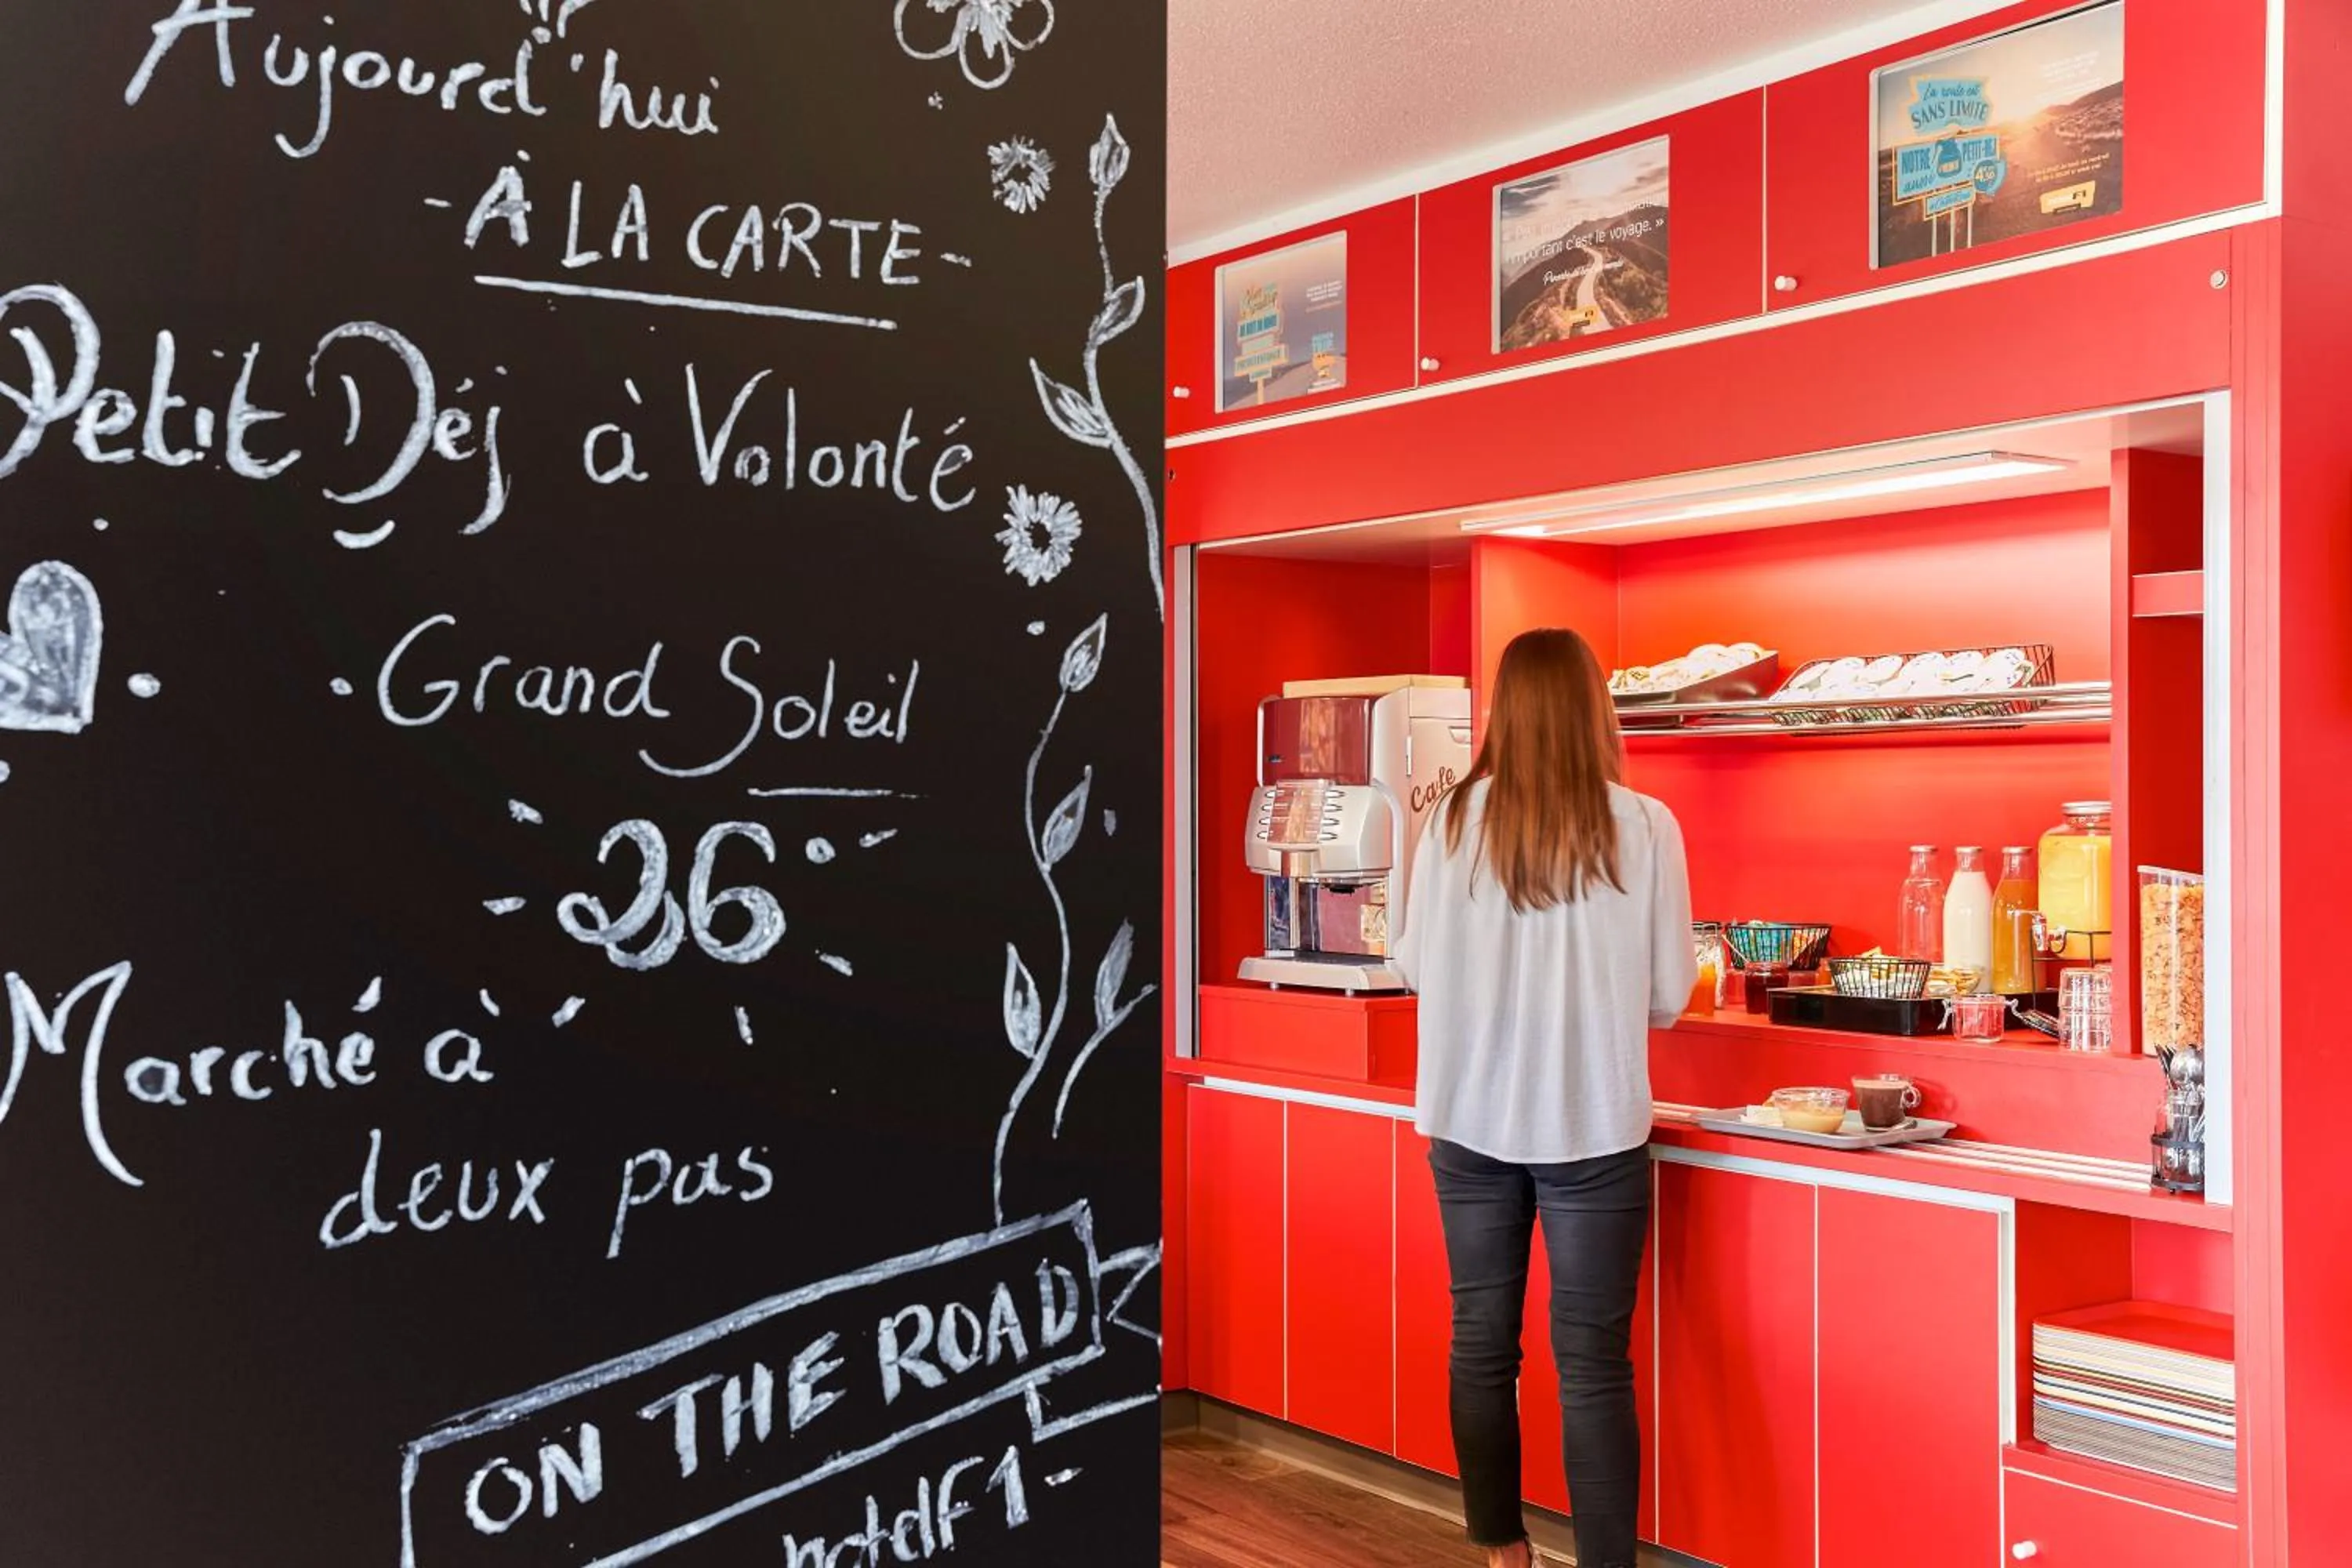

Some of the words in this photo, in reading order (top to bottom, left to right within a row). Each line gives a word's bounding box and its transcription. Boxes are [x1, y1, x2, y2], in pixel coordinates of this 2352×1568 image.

[124, 0, 720, 158] Aujourd'hui
[561, 180, 650, 270] LA
[0, 282, 302, 480] Petit
[685, 362, 976, 512] Volonté
[377, 613, 670, 726] Grand
[638, 635, 920, 778] Soleil
[0, 960, 383, 1186] Marché
[319, 1129, 555, 1248] deux
[606, 1145, 773, 1259] pas
[465, 1421, 603, 1534] ON
[637, 1330, 848, 1478] THE
[877, 1258, 1079, 1405] ROAD
